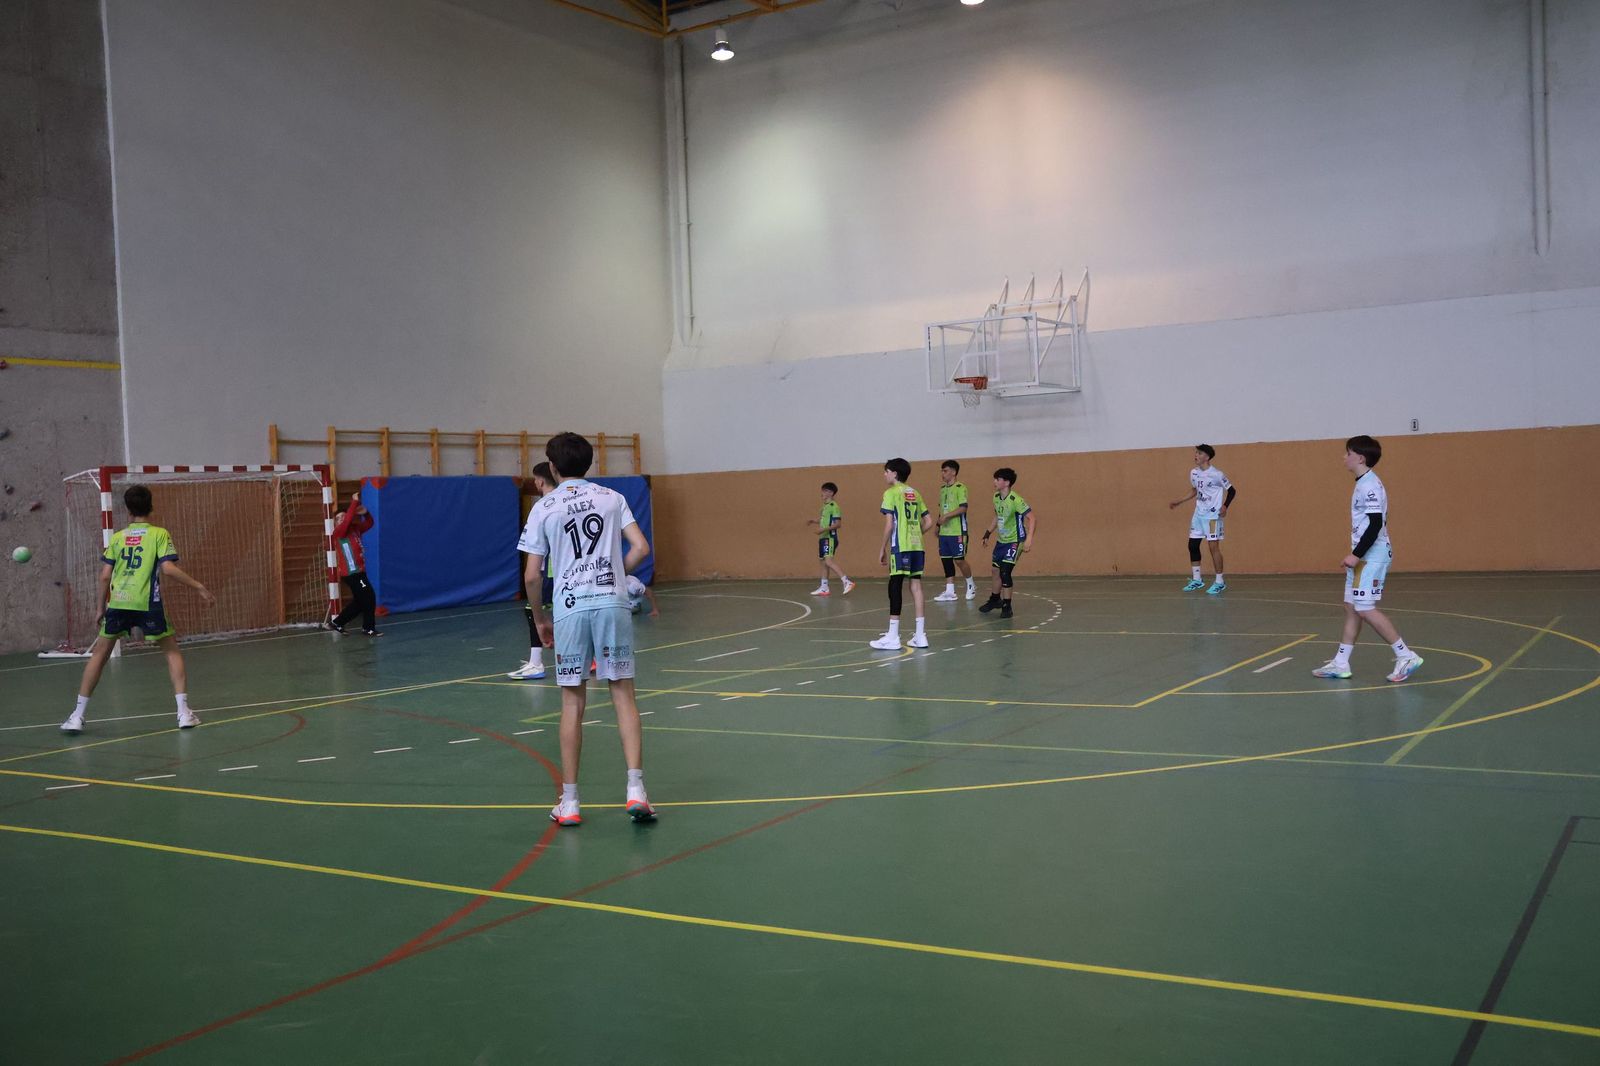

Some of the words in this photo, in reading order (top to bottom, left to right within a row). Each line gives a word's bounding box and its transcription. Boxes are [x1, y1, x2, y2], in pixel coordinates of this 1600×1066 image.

[567, 499, 596, 516] ALEX
[904, 501, 918, 520] 67
[563, 512, 604, 560] 19
[958, 543, 964, 552] 9
[1006, 548, 1017, 558] 17
[121, 545, 144, 570] 46
[359, 579, 367, 588] 1
